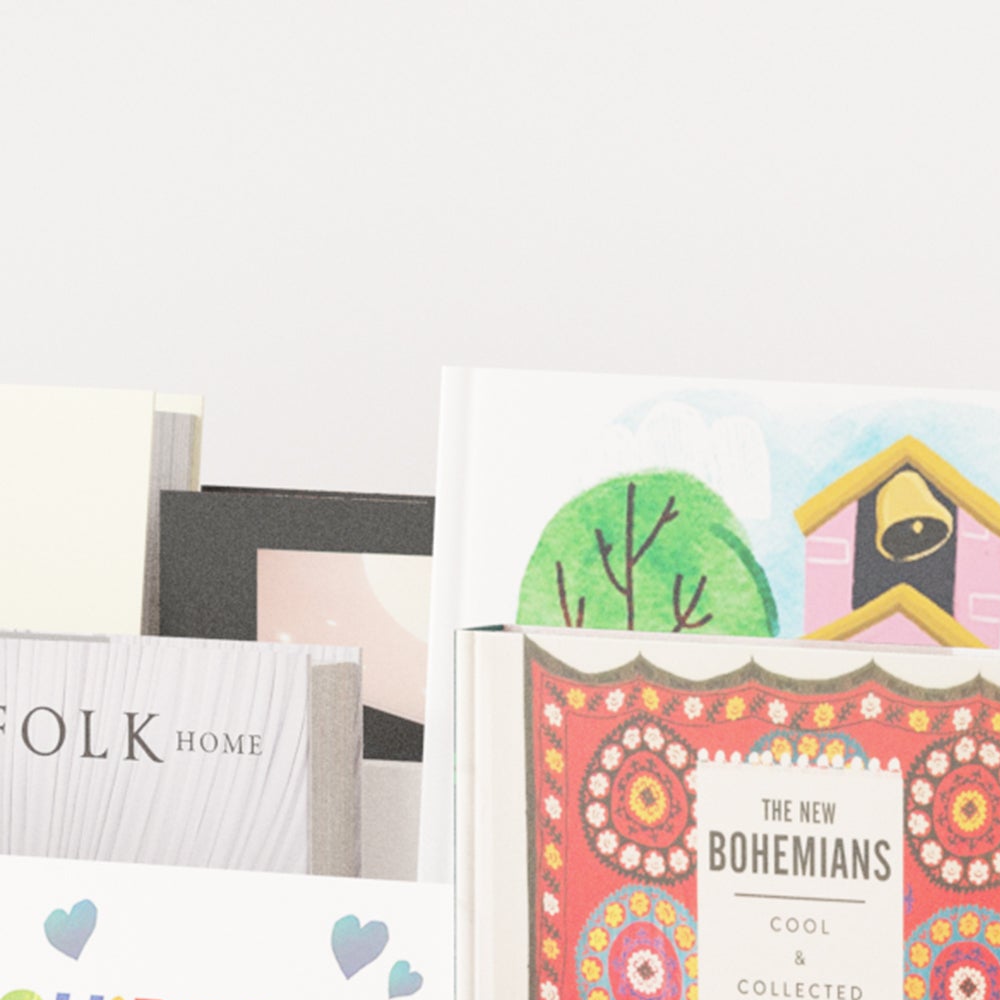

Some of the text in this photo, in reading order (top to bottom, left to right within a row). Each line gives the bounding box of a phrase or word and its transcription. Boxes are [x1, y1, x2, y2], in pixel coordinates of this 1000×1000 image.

[176, 730, 264, 756] HOME
[761, 799, 836, 825] THE NEW
[708, 830, 892, 882] BOHEMIANS
[770, 916, 830, 935] COOL
[794, 950, 806, 966] &
[737, 979, 863, 1000] COLLECTED
